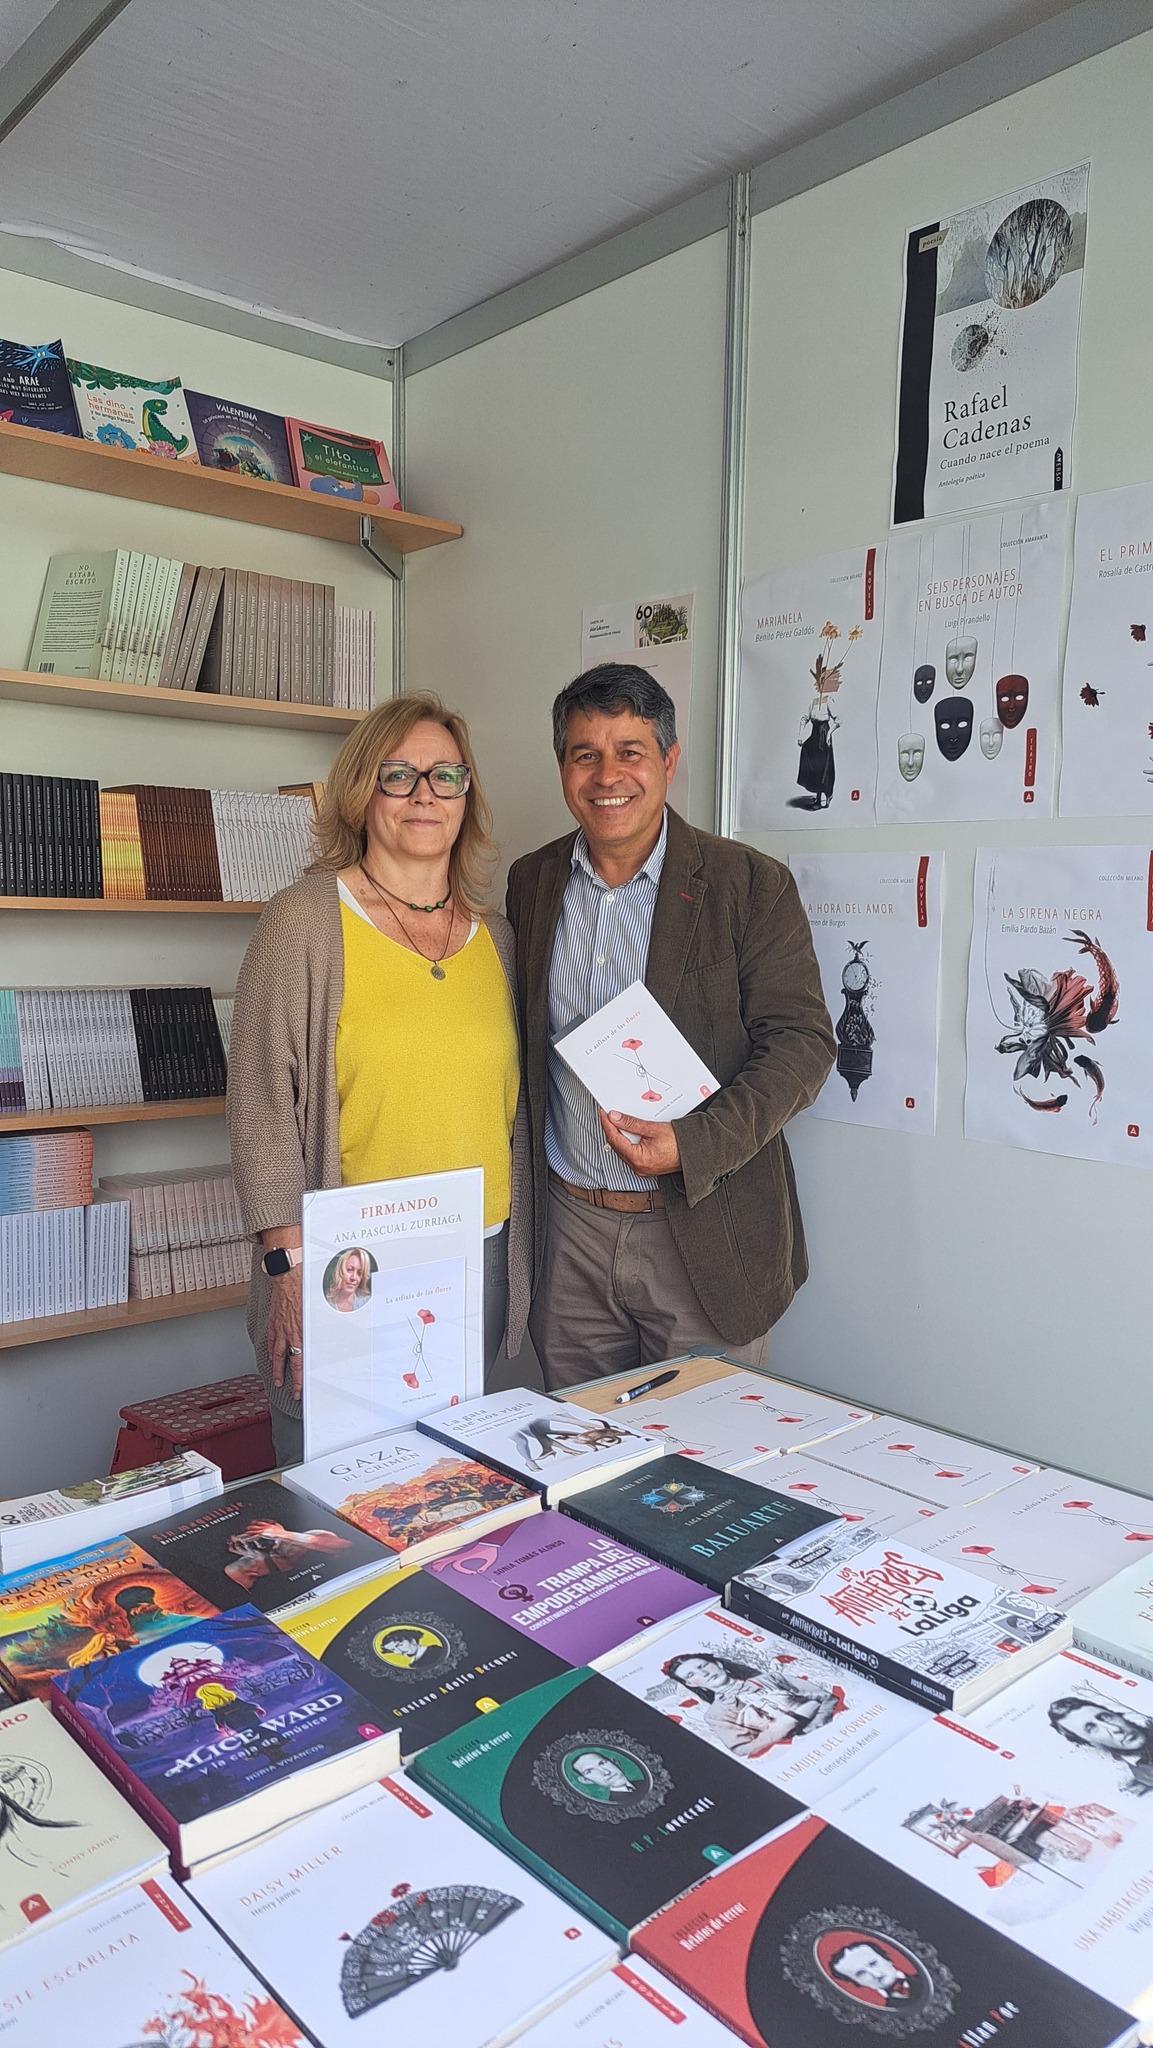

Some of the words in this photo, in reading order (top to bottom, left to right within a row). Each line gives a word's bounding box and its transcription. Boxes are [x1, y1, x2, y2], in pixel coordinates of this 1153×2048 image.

[921, 234, 943, 248] poesía
[19, 375, 40, 386] ARAE
[86, 393, 103, 404] Las
[105, 398, 126, 410] dino
[88, 402, 134, 419] hermanas
[216, 403, 258, 422] VALENTINA
[943, 384, 1008, 423] Rafael
[942, 414, 1032, 450] Cadenas
[325, 456, 369, 473] elefantito
[939, 453, 977, 470] Cuando
[979, 450, 1003, 463] nace
[1004, 443, 1014, 455] el
[1015, 437, 1050, 456] poema
[938, 475, 963, 489] Antología
[964, 471, 986, 484] poética
[1100, 548, 1113, 562] EL
[1120, 541, 1152, 559] PRIM
[927, 580, 949, 596] SEIS
[952, 568, 1016, 592] PERSONAJES
[1098, 567, 1122, 579] Rosalía
[1124, 565, 1132, 575] de
[918, 598, 932, 612] EN
[935, 592, 968, 610] BUSCA
[971, 590, 985, 603] DE
[987, 583, 1023, 600] AUTOR
[636, 605, 652, 620] 60
[757, 611, 802, 629] MARIANELA
[944, 615, 958, 629] Luigi
[960, 613, 991, 627] Pirandello
[755, 632, 774, 643] Benito
[776, 628, 791, 640] Pérez
[792, 625, 815, 638] Galdós
[817, 903, 841, 914] HORA
[845, 903, 862, 914] DEL
[866, 903, 894, 914] AMOR
[1002, 907, 1015, 919] LA
[1019, 907, 1059, 920] SIRENA
[1064, 909, 1103, 921] NEGRA
[829, 919, 846, 928] Burgos
[1001, 924, 1018, 933] Emilia
[1019, 925, 1037, 934] Pardo
[1038, 925, 1057, 935] Bazán
[584, 1047, 593, 1056] La
[593, 1034, 611, 1050] asfixia
[610, 1028, 618, 1036] de
[625, 1010, 642, 1025] flores
[360, 1196, 438, 1219] FIRMANDO
[333, 1231, 357, 1244] ANA
[360, 1222, 407, 1239] PASCUAL
[410, 1214, 462, 1232] ZURRIAGA
[395, 1292, 414, 1303] asfixia
[416, 1290, 424, 1298] de
[425, 1288, 434, 1296] las
[435, 1285, 452, 1295] flores
[442, 1418, 458, 1427] La
[462, 1409, 488, 1423] gata
[453, 1420, 475, 1432] que
[477, 1412, 498, 1423] nos
[500, 1401, 533, 1414] vigila
[329, 1445, 413, 1476] GAZA
[341, 1472, 362, 1483] EL
[363, 1452, 421, 1475] CRIMEN
[619, 1481, 634, 1493] PAUL
[635, 1473, 654, 1486] RIVER
[152, 1529, 176, 1542] Sin
[177, 1501, 246, 1533] maquillaje
[685, 1514, 701, 1527] SAGA
[700, 1498, 736, 1520] ELEMENTOS
[160, 1531, 187, 1546] Relatos
[187, 1525, 202, 1537] tras
[209, 1511, 240, 1527] tormenta
[690, 1500, 796, 1559] BALUARTE
[493, 1561, 515, 1576] SONIA
[515, 1550, 540, 1567] TOMÁS
[538, 1539, 566, 1556] ALONSO
[587, 1537, 618, 1553] LA
[536, 1558, 606, 1592] TRAMPA
[597, 1548, 635, 1569] DEL
[836, 1566, 860, 1583] LOS
[511, 1555, 651, 1627] EMPODERAMIENTO
[642, 1617, 652, 1626] A
[888, 1607, 912, 1622] DE
[898, 1594, 981, 1638] LaLiga
[835, 1636, 868, 1663] LaLiga
[1092, 1645, 1134, 1671] ESTABA
[393, 1693, 438, 1718] Gustavo
[439, 1672, 475, 1696] Adolfo
[475, 1650, 519, 1675] Bécquer
[910, 1677, 922, 1690] JOSÉ
[923, 1684, 947, 1701] QUESADA
[164, 1728, 260, 1777] ALICE
[259, 1693, 343, 1733] WARD
[365, 1726, 375, 1736] A
[777, 1771, 794, 1783] LA
[790, 1749, 826, 1774] MUJER
[821, 1736, 844, 1752] DEL
[840, 1704, 887, 1737] PORVENIR
[199, 1767, 210, 1776] y
[212, 1758, 226, 1770] la
[229, 1744, 259, 1762] caja
[262, 1736, 279, 1748] de
[282, 1715, 328, 1739] música
[278, 1743, 325, 1767] VIVANCOS
[452, 1748, 483, 1769] Relatos
[480, 1742, 492, 1753] de
[489, 1731, 512, 1747] terror
[819, 1745, 861, 1776] Concepción
[856, 1728, 881, 1747] Arenal
[657, 1796, 715, 1836] Lovecraft
[711, 1849, 724, 1860] A
[240, 1878, 284, 1907] DAISY
[288, 1845, 343, 1882] MILLER
[250, 1900, 276, 1918] Henry
[275, 1887, 301, 1908] James
[679, 1924, 715, 1952] Relatos
[708, 1917, 725, 1932] de
[718, 1901, 748, 1924] terror
[1073, 1928, 1103, 1952] UNA
[42, 1933, 140, 1991] ESCARLATA
[988, 2001, 1020, 2025] Poe
